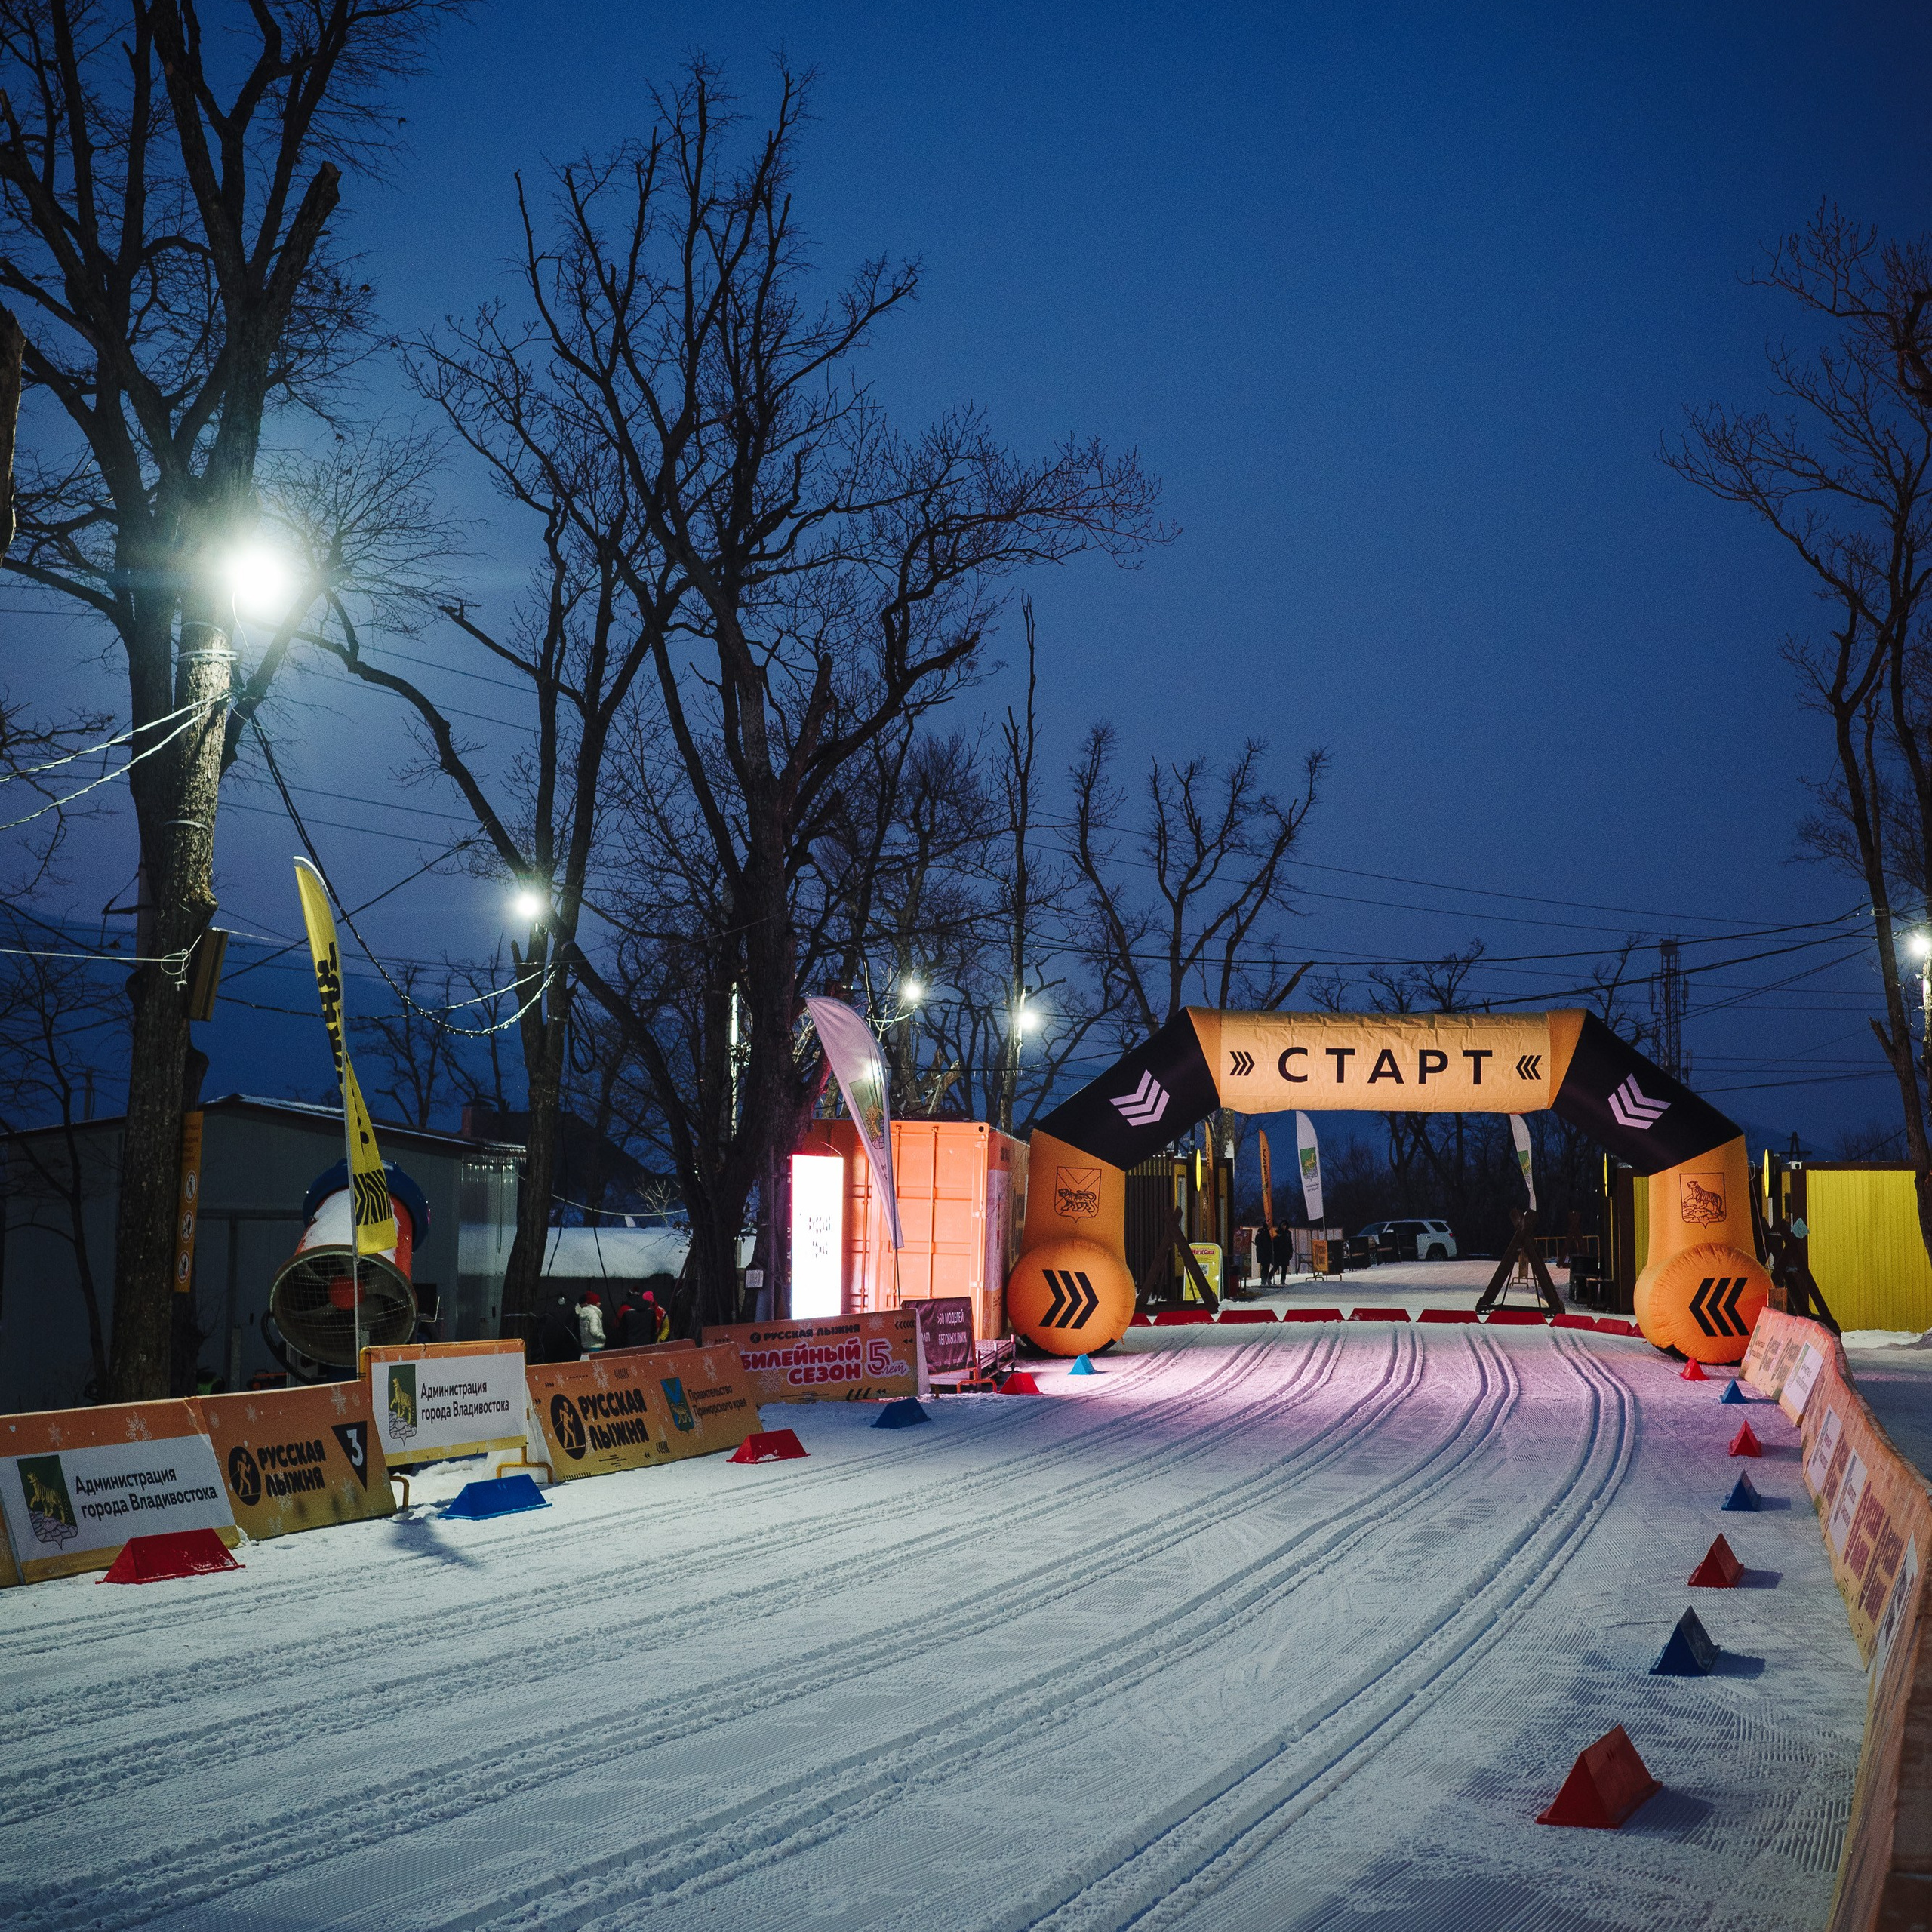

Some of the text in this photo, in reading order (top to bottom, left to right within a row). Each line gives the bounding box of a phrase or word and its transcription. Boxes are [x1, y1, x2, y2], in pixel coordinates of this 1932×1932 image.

[1278, 1047, 1493, 1084] СТАРТ
[945, 1309, 964, 1327] МОДЕЛЕЙ
[764, 1324, 860, 1341] РУССКАЯ ЛЫЖНЯ
[938, 1333, 957, 1346] БЕГОВЫХ
[740, 1338, 861, 1370] БИЛЕЙНЫЙ
[868, 1340, 906, 1374] 5 лет
[789, 1363, 861, 1384] СЕЗОН
[421, 1382, 487, 1400] Администрация
[577, 1389, 648, 1420] РУССКАЯ
[688, 1385, 733, 1401] Правительство
[421, 1400, 509, 1423] города Владивостока
[692, 1398, 747, 1419] Приморского края
[346, 1429, 363, 1466] 3
[589, 1418, 649, 1451] ЛЫЖНЯ
[257, 1440, 326, 1470] РУССКАЯ
[75, 1469, 177, 1495] Администрация
[265, 1466, 325, 1497] ЛЫЖНЯ
[81, 1486, 218, 1521] города Владивостока
